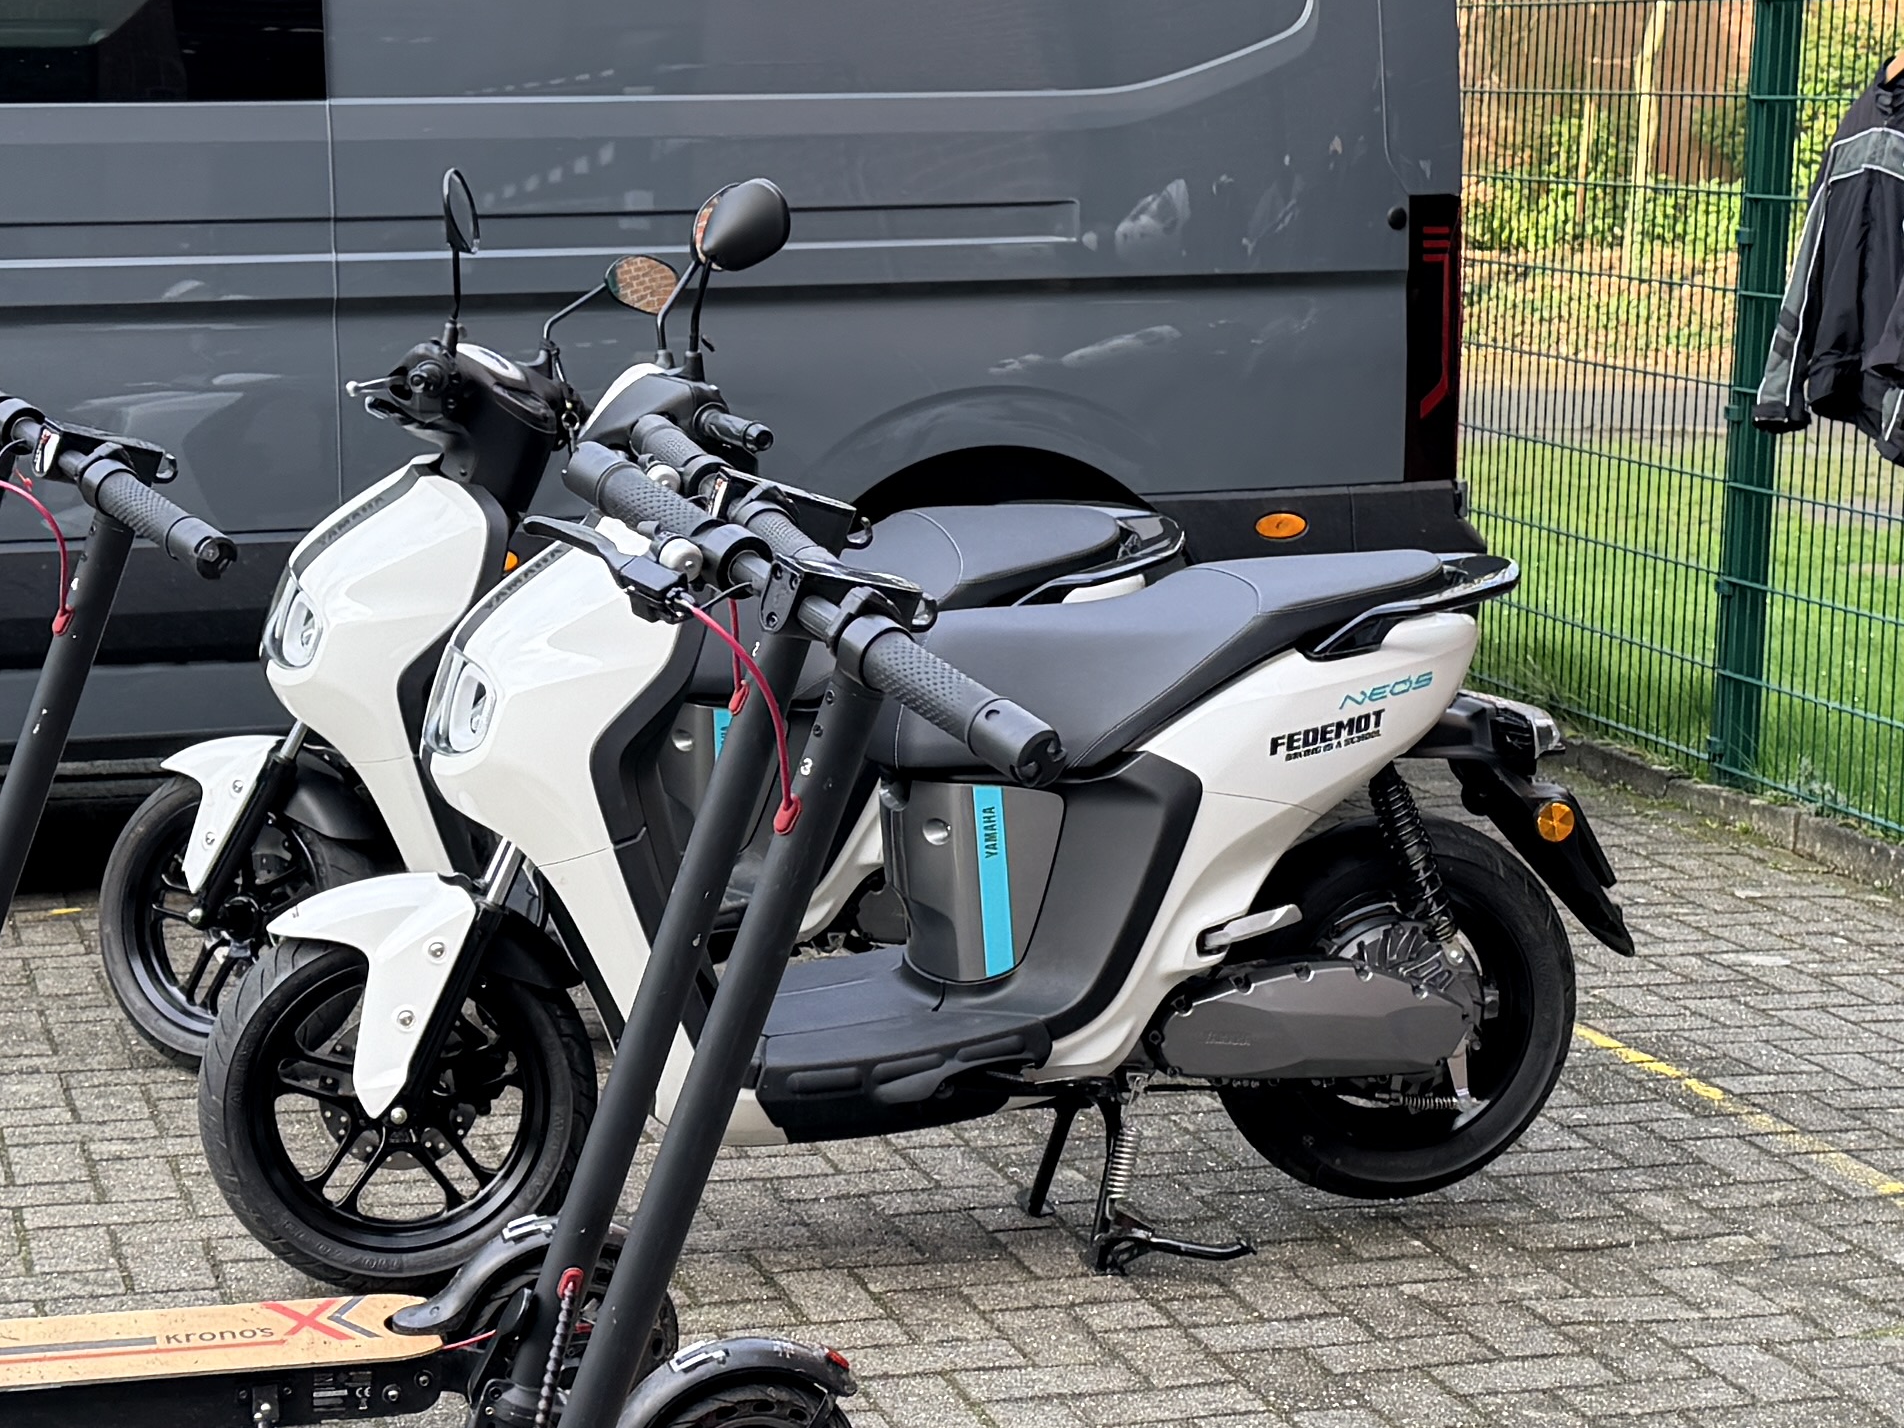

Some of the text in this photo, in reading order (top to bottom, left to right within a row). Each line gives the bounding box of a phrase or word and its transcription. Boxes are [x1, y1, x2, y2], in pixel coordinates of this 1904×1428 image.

[1269, 708, 1385, 756] FEDEMOT
[1335, 740, 1342, 749] A
[800, 757, 813, 776] 3
[982, 806, 998, 859] YAMAHA
